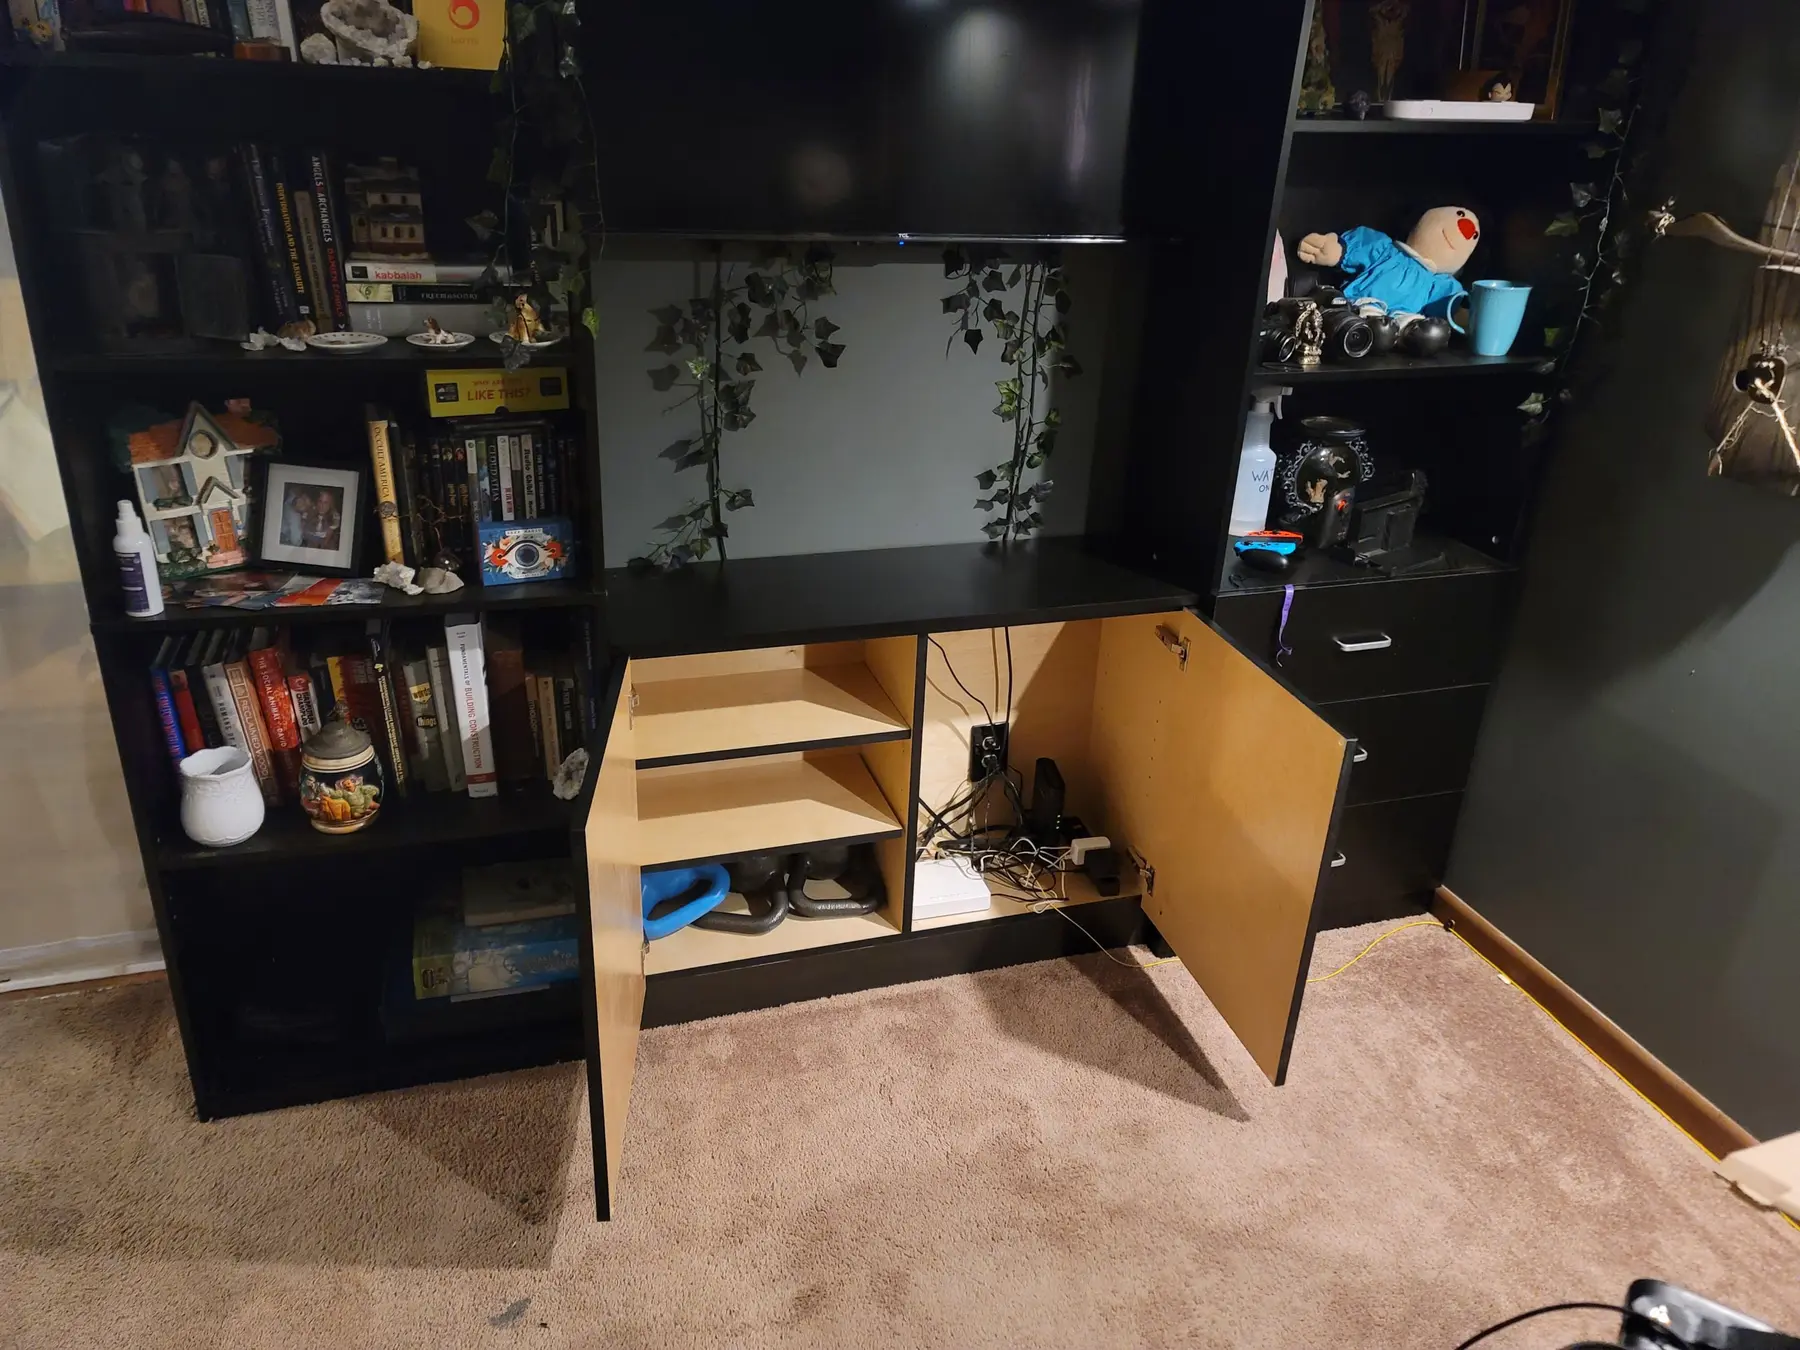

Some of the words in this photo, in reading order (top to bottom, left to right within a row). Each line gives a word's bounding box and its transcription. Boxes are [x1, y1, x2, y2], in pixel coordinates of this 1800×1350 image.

[311, 155, 324, 186] ANGELS
[316, 191, 333, 243] ARCHANGELS
[286, 231, 296, 247] AND
[288, 246, 298, 261] THE
[291, 260, 305, 294] ABSOLUTE
[374, 270, 422, 280] kabbalah
[420, 291, 478, 300] FREEMASONRY
[467, 389, 495, 401] LIKE
[498, 388, 531, 399] THIS?
[374, 427, 385, 460] OCCULT
[488, 444, 498, 477] CLOUD
[524, 448, 532, 472] Studio
[378, 460, 390, 498] AMERICA
[490, 476, 500, 502] ATLAS
[525, 474, 534, 496] Ghibli
[460, 643, 469, 680] FUNDAMENTALS
[257, 656, 265, 668] THE
[261, 668, 272, 697] SOCIAL
[269, 696, 280, 722] ANIMAL
[276, 727, 287, 748] DAVID
[413, 686, 432, 699] words
[464, 687, 476, 718] BUILDING
[219, 703, 231, 731] HUMANS
[417, 716, 438, 728] things
[239, 699, 260, 752] RECLAIMED
[255, 751, 270, 779] WOOD
[468, 717, 482, 769] CONSTRUCTION
